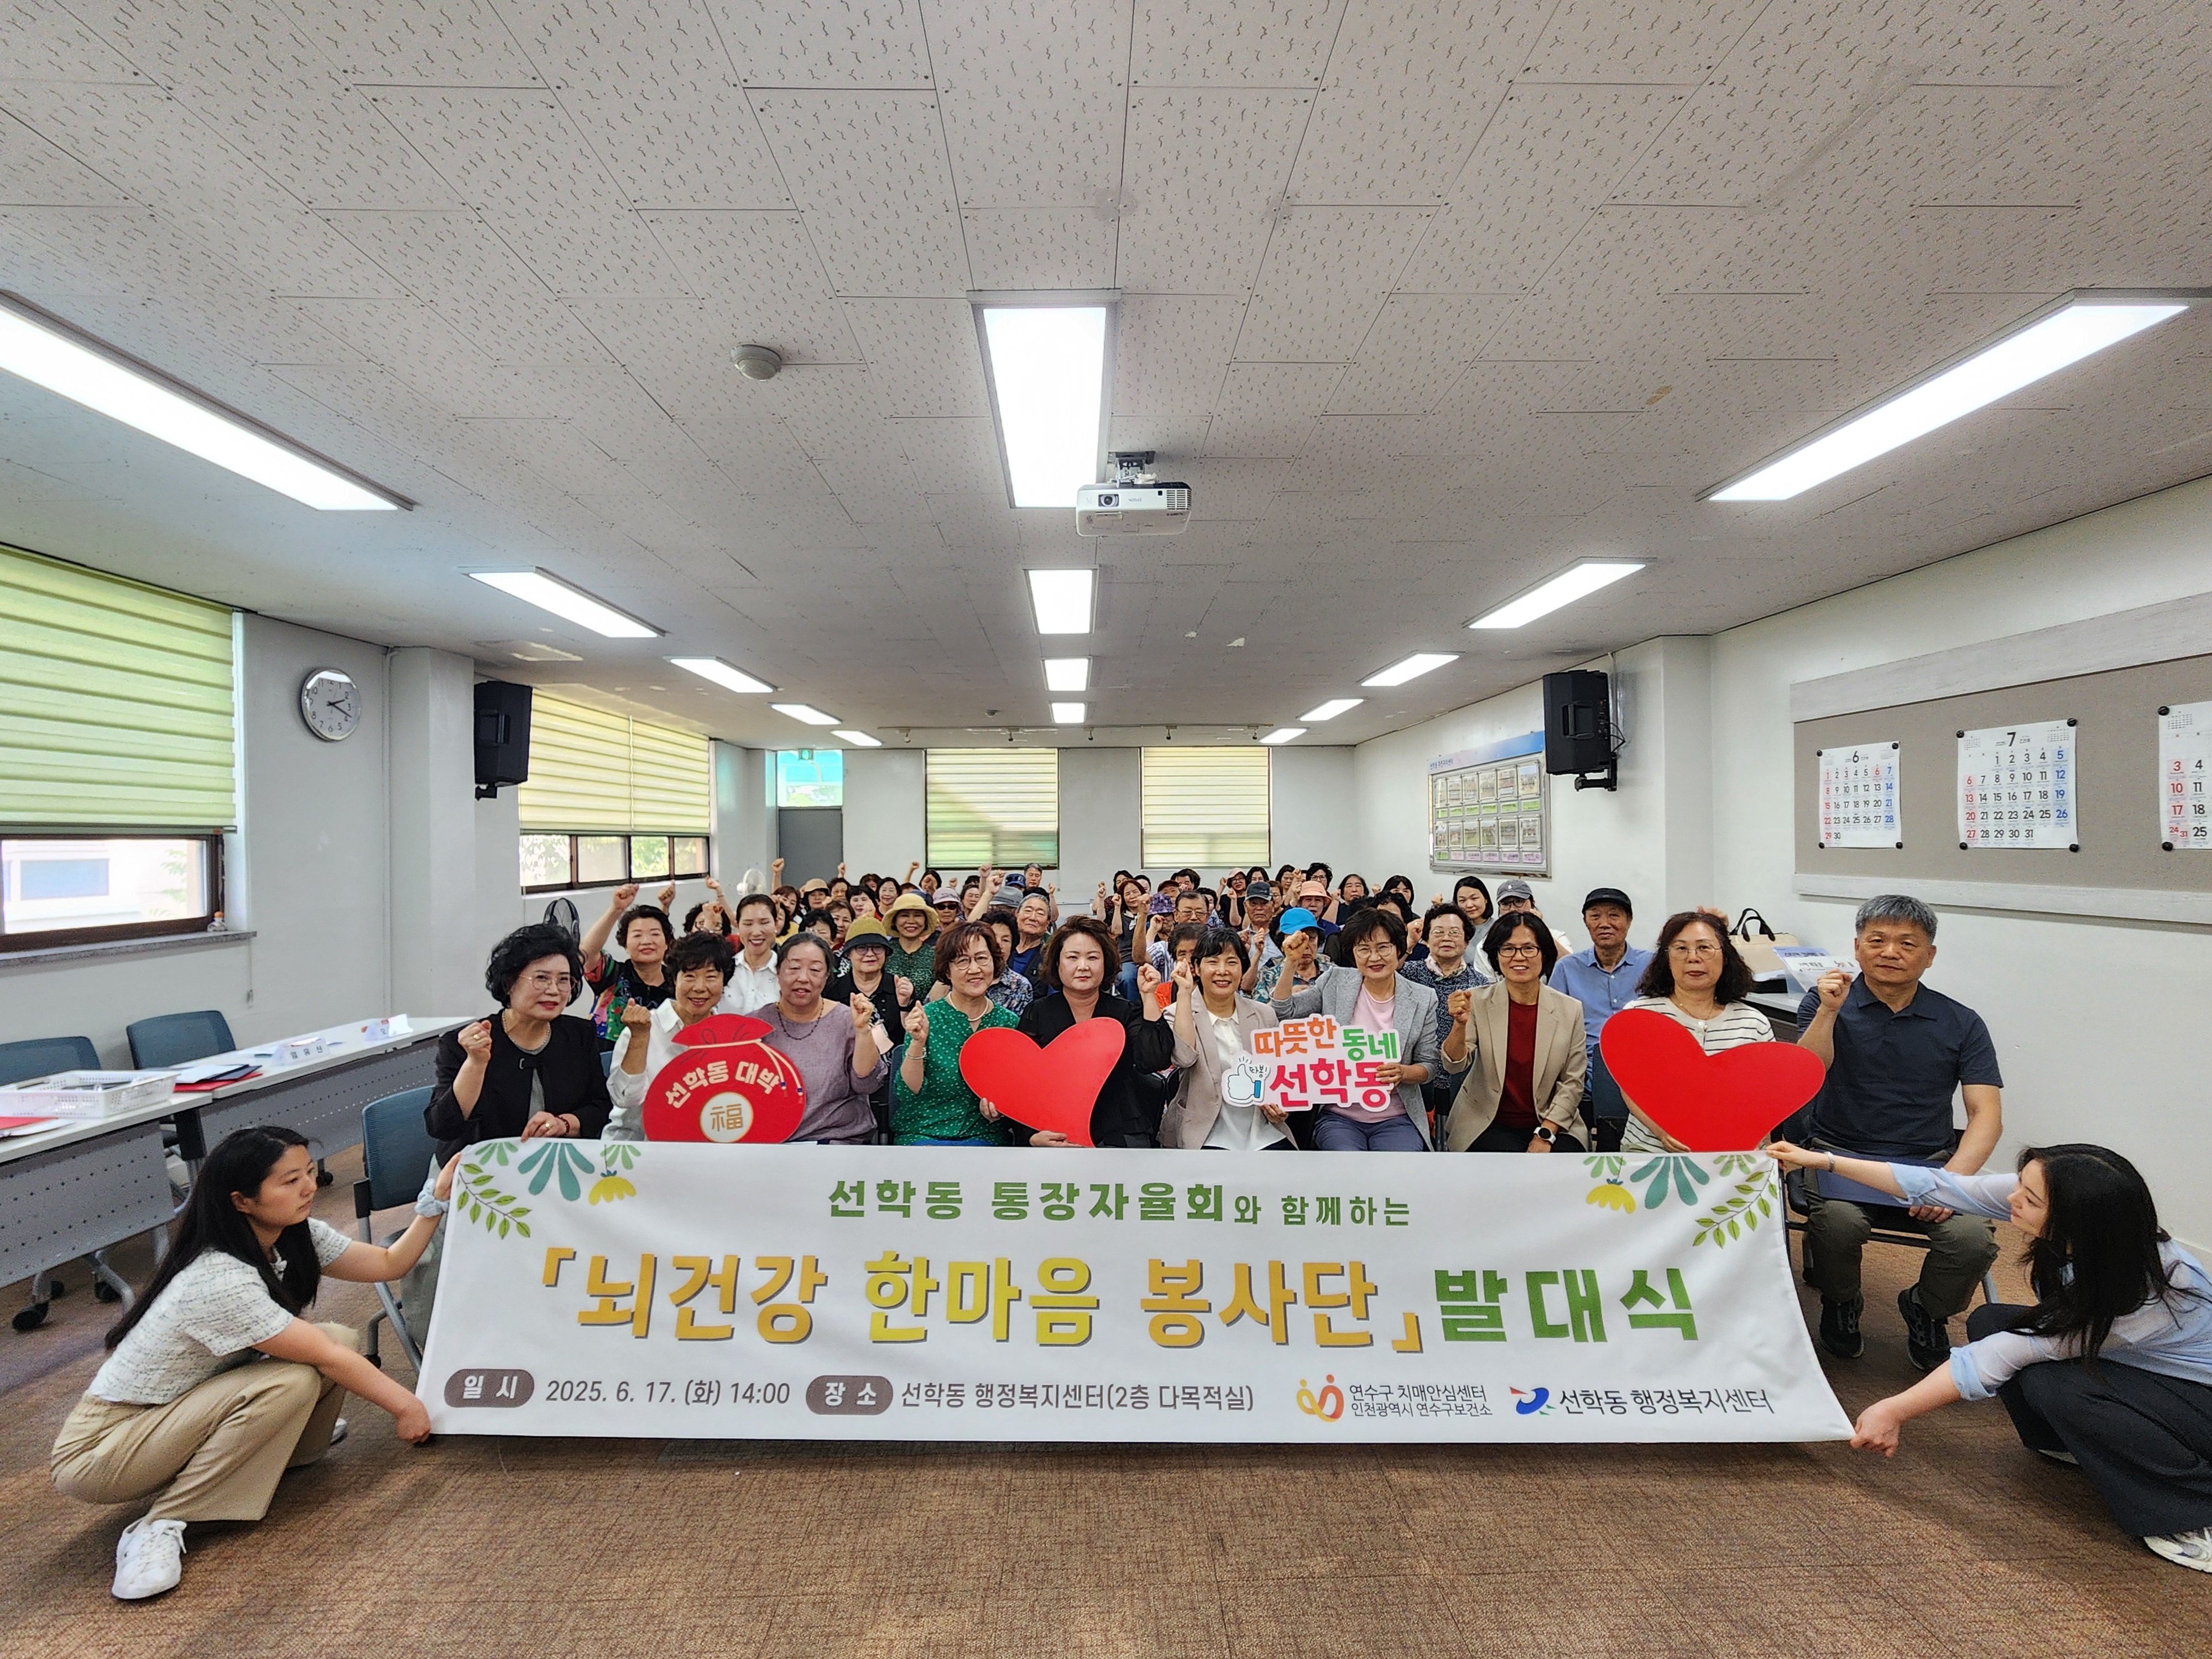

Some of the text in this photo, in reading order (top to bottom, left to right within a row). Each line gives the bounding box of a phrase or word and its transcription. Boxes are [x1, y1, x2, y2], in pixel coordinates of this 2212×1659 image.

[311, 711, 316, 720] 8
[2007, 732, 2016, 747] 7
[1853, 751, 1859, 763] 6
[1995, 750, 2064, 764] 1 2 3 4 5
[2173, 760, 2203, 771] 3 4
[1967, 770, 2065, 785] 6 7 8 9 10 11 12
[2171, 782, 2201, 793] 10 11
[1965, 790, 2065, 802] 13 14 15 16 17 18 19
[1980, 812, 1988, 820] 21
[1994, 811, 2004, 820] 22
[2008, 811, 2018, 819] 23
[2023, 810, 2034, 819] 24
[2039, 810, 2051, 818] 25
[2056, 809, 2068, 818] 26
[2172, 804, 2205, 815] 17 18
[1994, 830, 2004, 838] 29
[2008, 830, 2020, 838] 30
[2025, 830, 2033, 838] 31
[2193, 827, 2207, 837] 25
[1254, 1017, 1397, 1061] 따뜻한 동네
[1249, 1064, 1268, 1078] 따봉!
[665, 1060, 780, 1109] 선학동 대박
[1269, 1058, 1390, 1107] 선학동
[709, 1103, 743, 1132] 福
[828, 1180, 1410, 1226] 선학동 통장자율회와 함께하는
[864, 1251, 1100, 1347] 한마음
[546, 1379, 790, 1406] 2025. 6. 17. (화) 14:00
[901, 1382, 966, 1408] 선학동
[1159, 1385, 1254, 1411] 다목적실)
[1349, 1384, 1487, 1402] 연수구 치매안심센터
[1351, 1402, 1493, 1417] 인천광역시 연수구보건소
[1559, 1389, 1775, 1415] 선학동 행정복지센터
